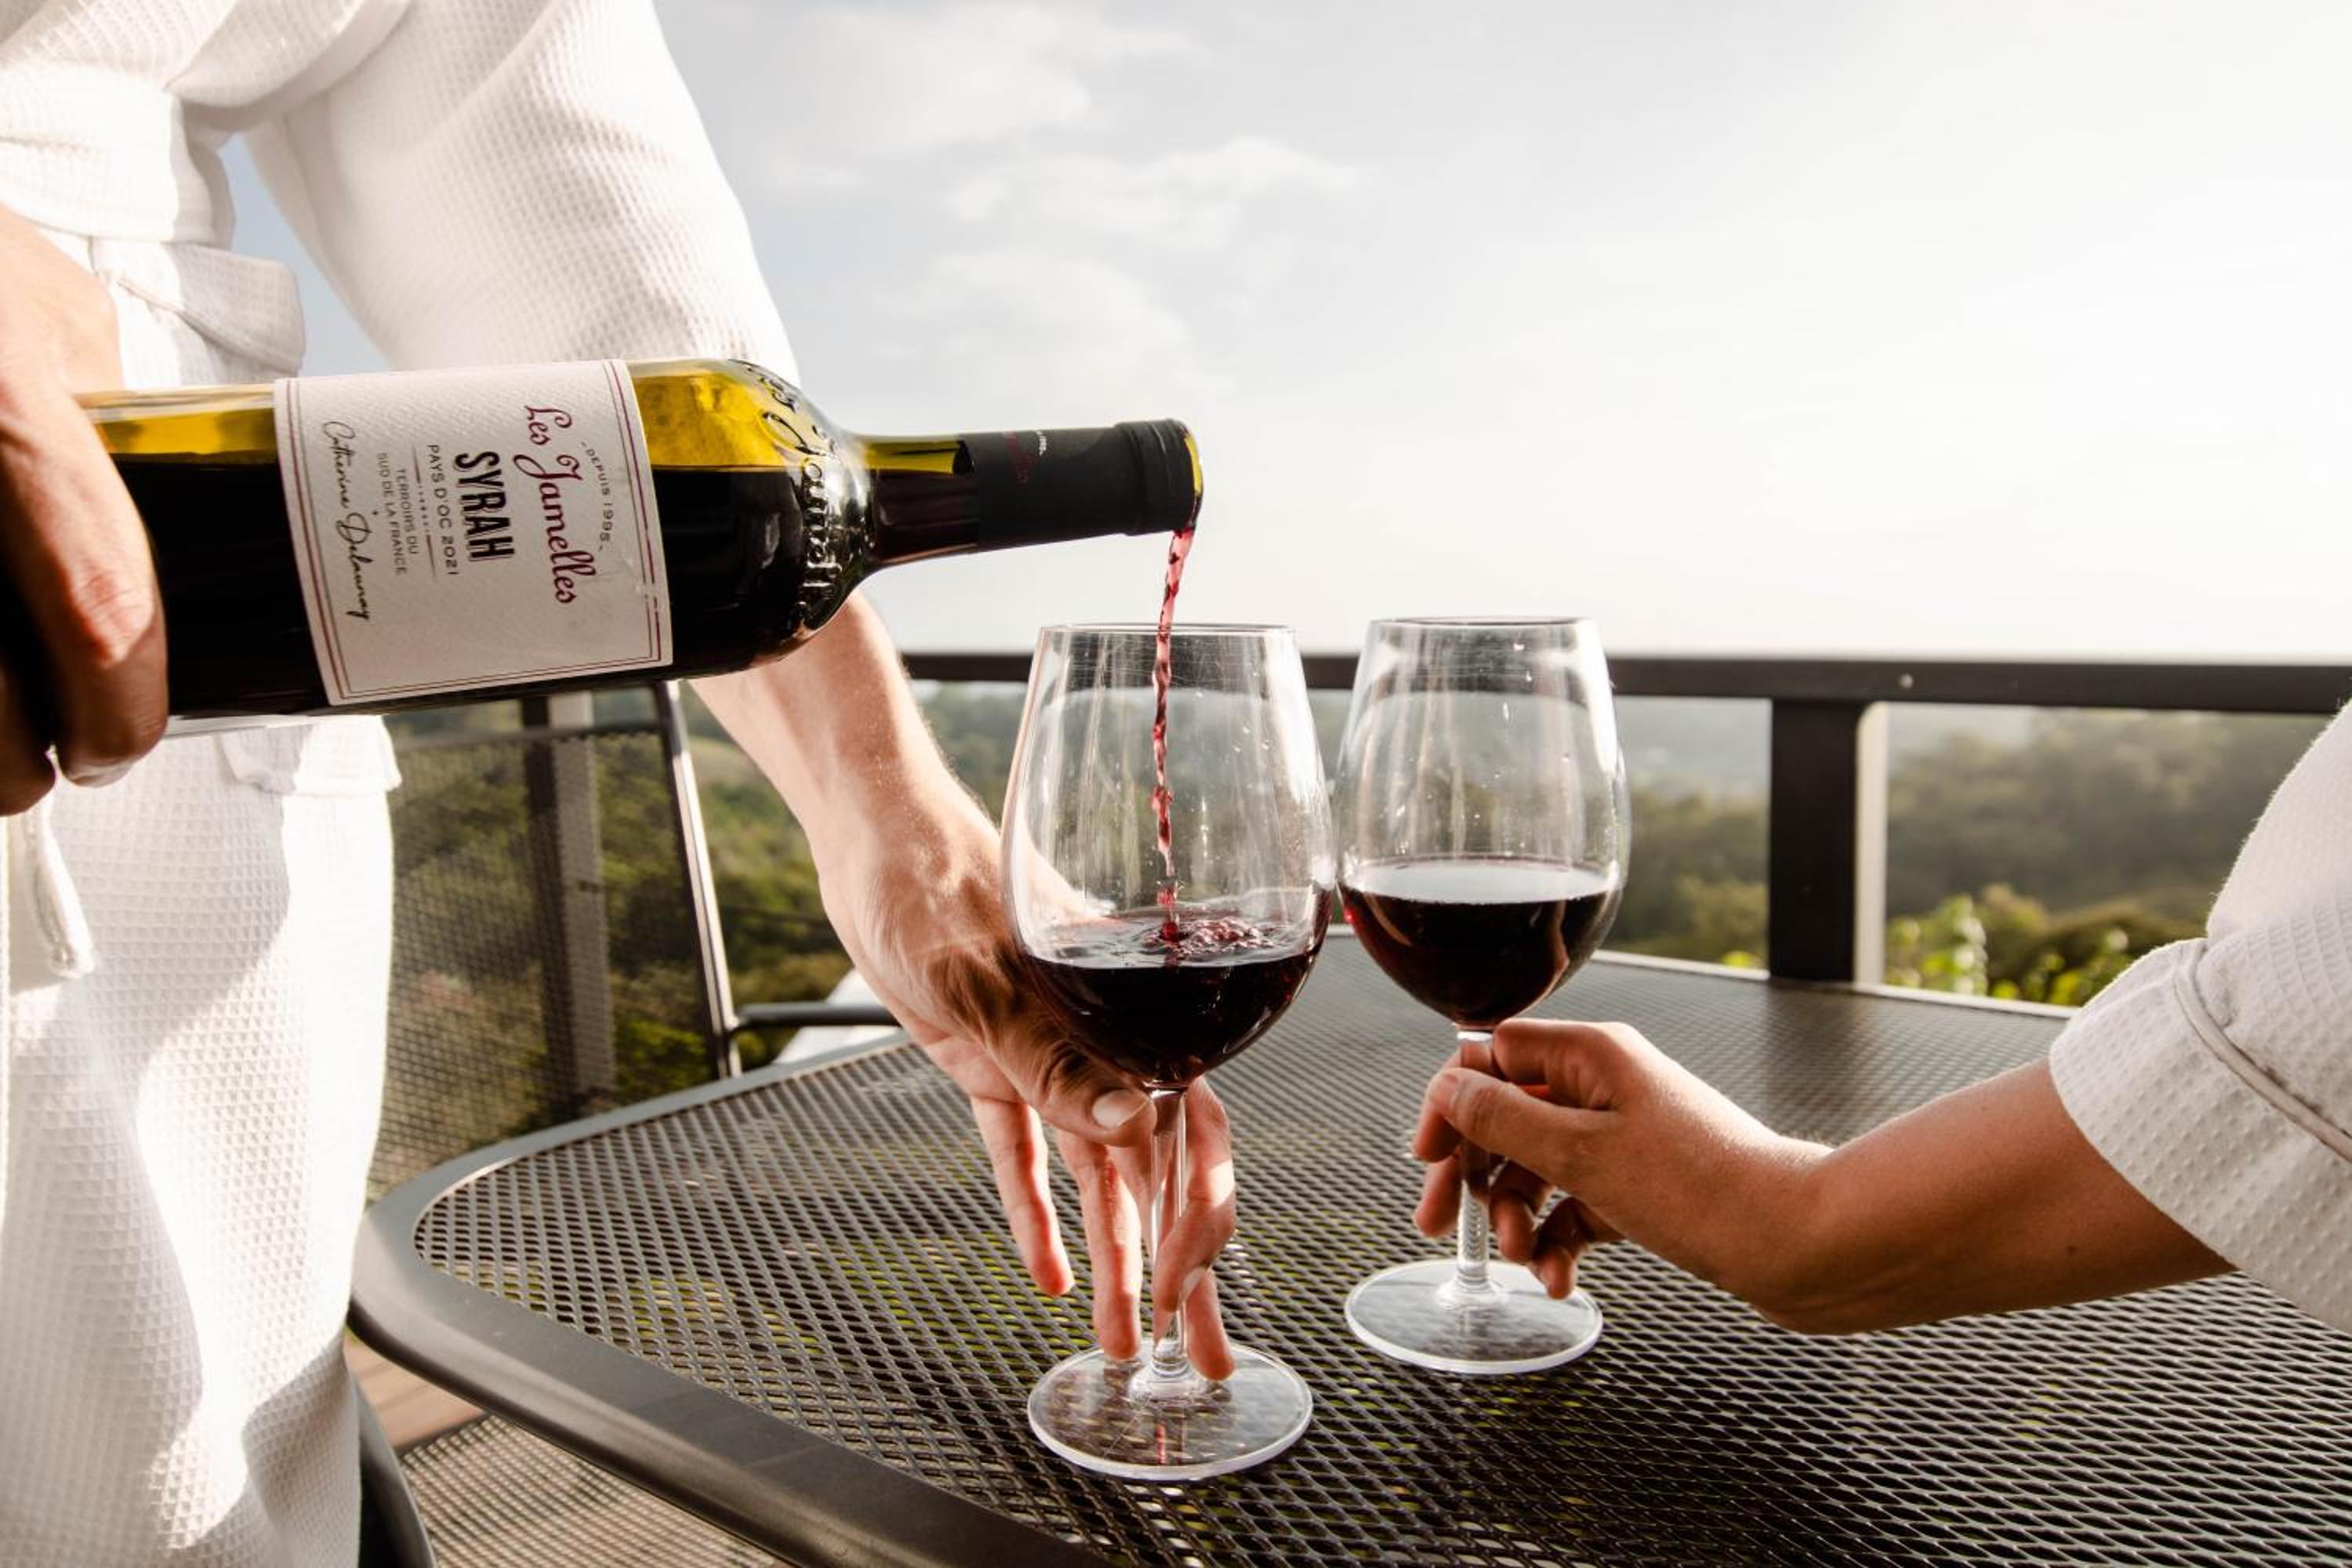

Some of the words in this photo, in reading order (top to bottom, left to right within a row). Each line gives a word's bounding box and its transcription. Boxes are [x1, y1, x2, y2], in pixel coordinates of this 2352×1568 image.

[524, 405, 572, 446] Les
[323, 421, 355, 509] Catherine
[376, 452, 391, 477] SUD
[427, 444, 445, 483] PAYS
[586, 448, 611, 496] DEPUIS
[382, 481, 394, 499] DE
[384, 503, 398, 518] LA
[395, 468, 416, 533] TERROIRS
[434, 487, 452, 529] D'OC
[452, 451, 515, 562] SYRAH
[389, 521, 408, 576] FRANCE
[405, 535, 419, 554] DU
[512, 453, 597, 604] Jamelles
[336, 512, 374, 620] Delaunay
[441, 536, 460, 575] 2021
